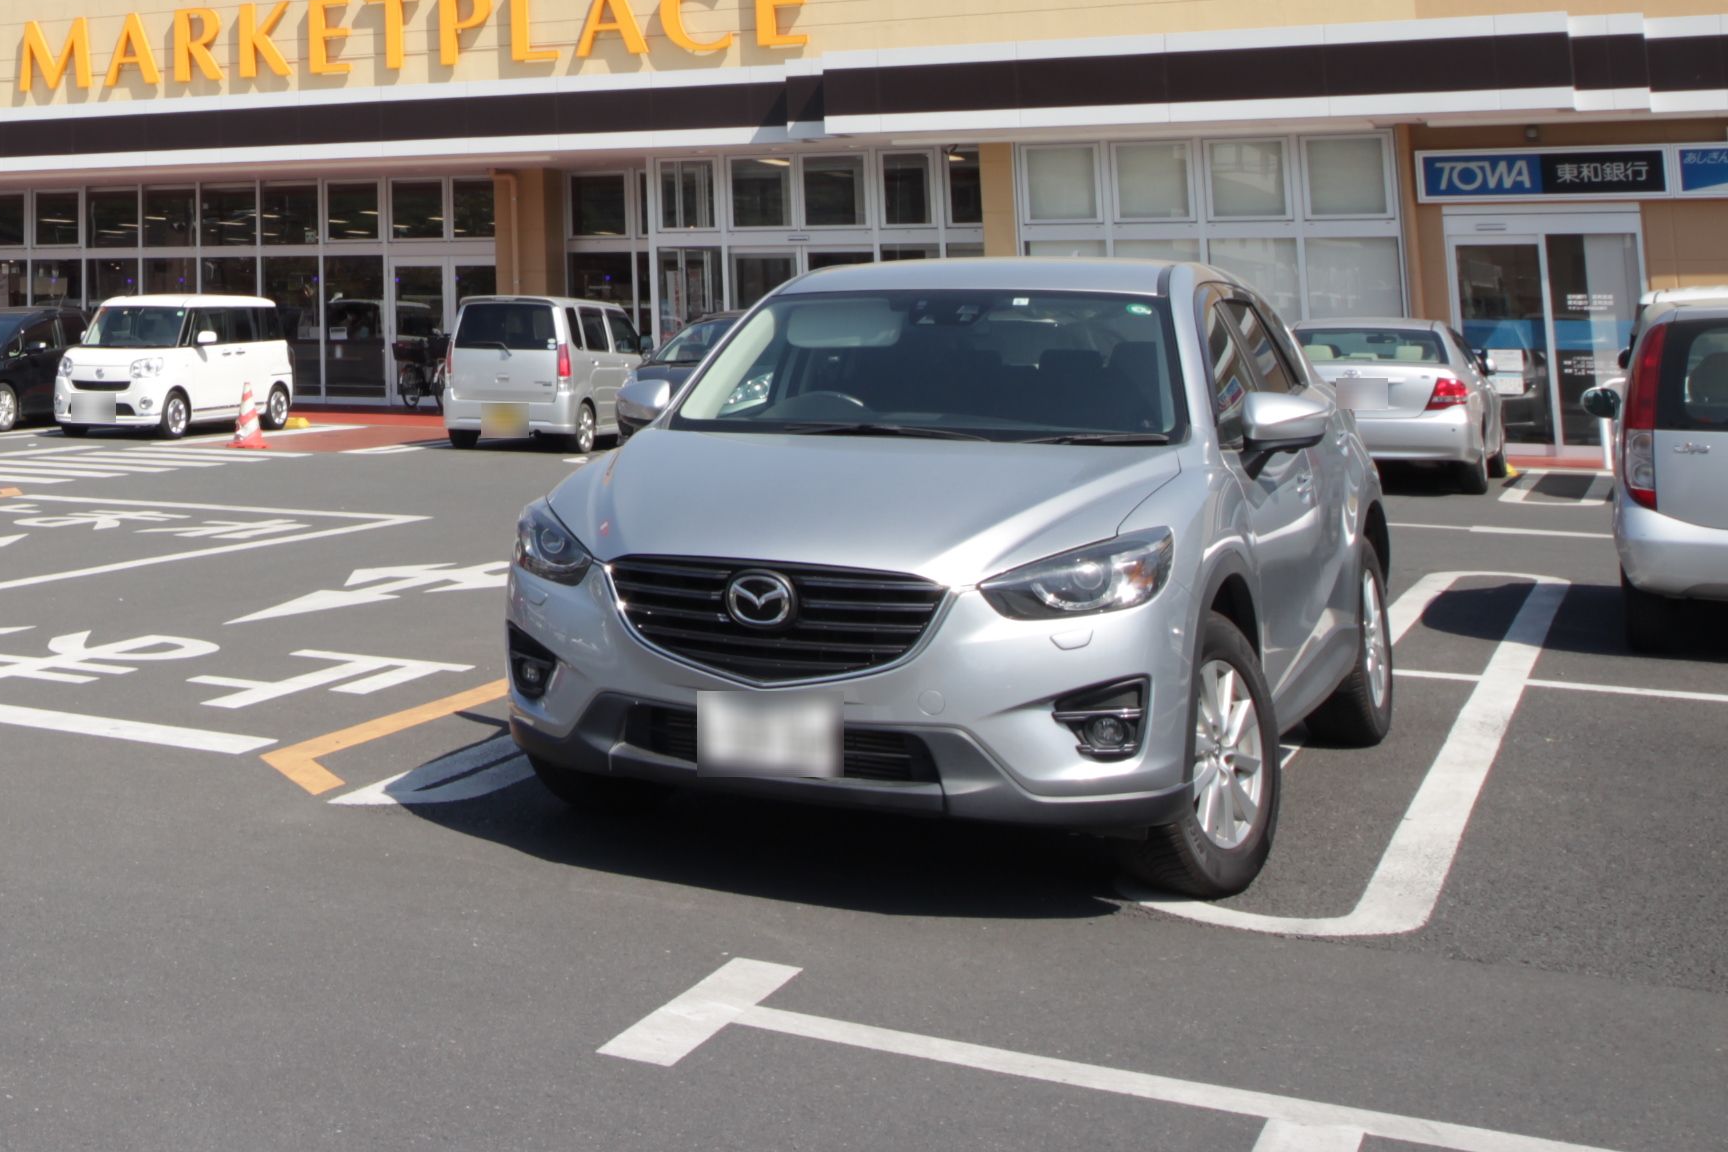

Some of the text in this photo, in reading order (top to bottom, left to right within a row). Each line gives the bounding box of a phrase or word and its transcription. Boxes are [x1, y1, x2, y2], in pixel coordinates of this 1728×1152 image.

[1434, 160, 1532, 190] TOWA
[1556, 161, 1649, 184] 東和銀行
